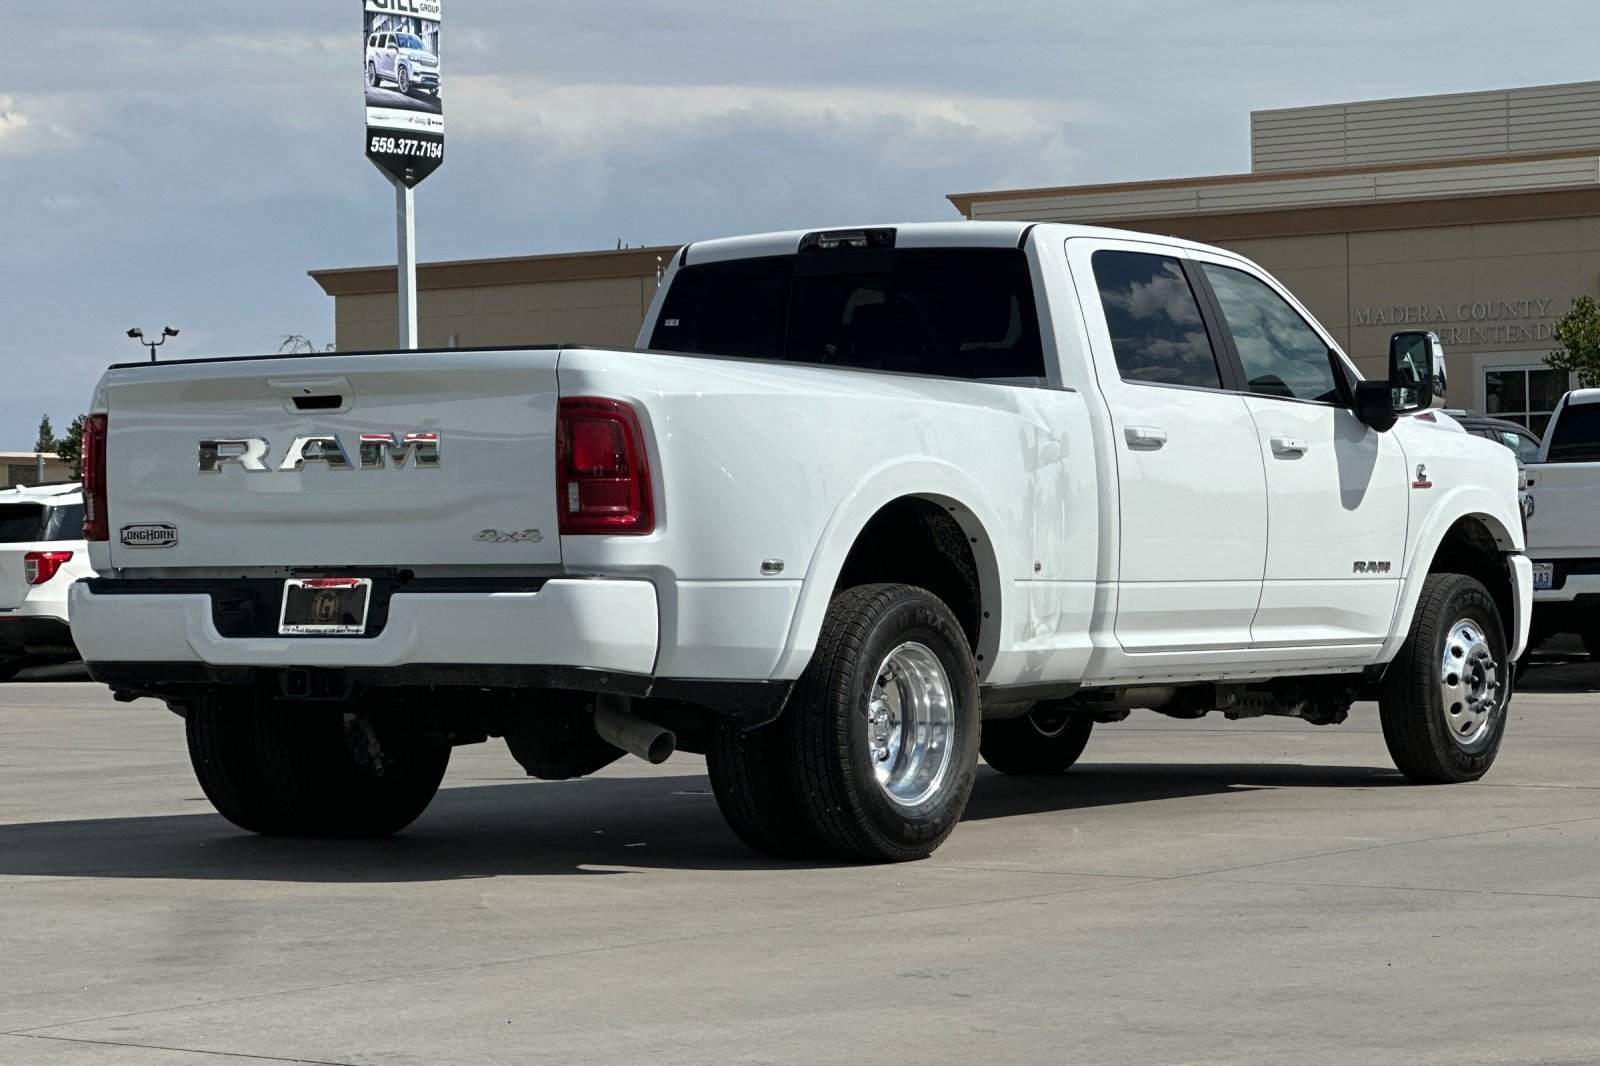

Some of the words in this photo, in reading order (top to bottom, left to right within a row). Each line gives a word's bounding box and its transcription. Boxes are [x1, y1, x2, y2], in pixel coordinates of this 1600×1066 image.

[420, 4, 439, 13] GROUP
[370, 136, 443, 158] 559.377.7154
[1355, 304, 1447, 325] MADERA
[1457, 299, 1550, 321] COUNTY
[198, 431, 441, 474] RAM
[1353, 561, 1391, 573] RAM
